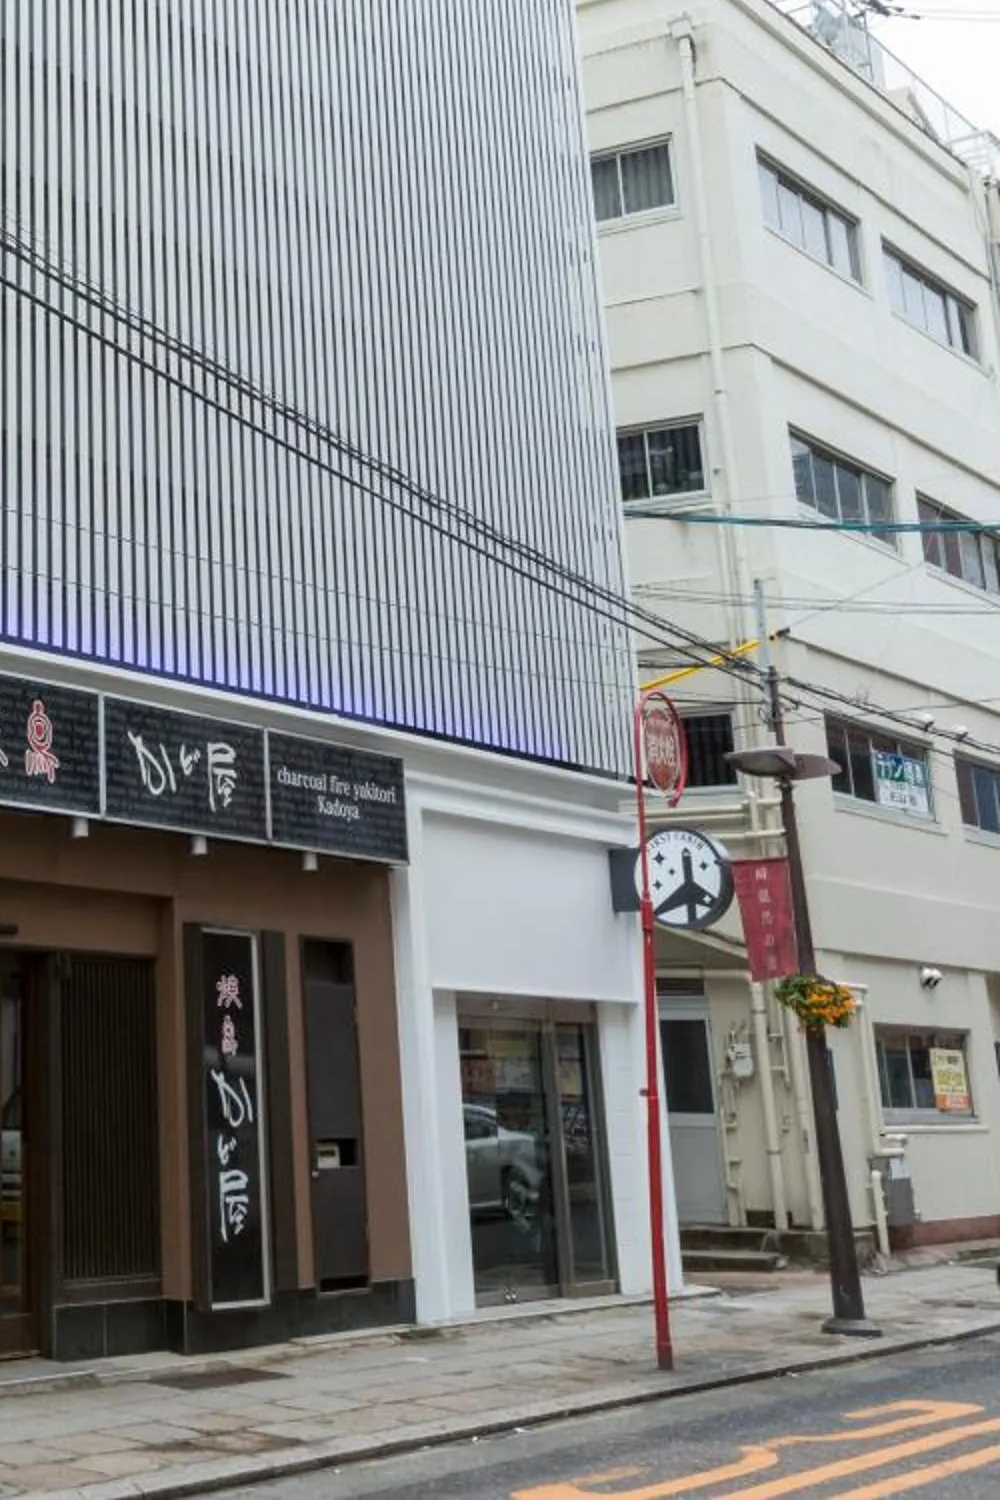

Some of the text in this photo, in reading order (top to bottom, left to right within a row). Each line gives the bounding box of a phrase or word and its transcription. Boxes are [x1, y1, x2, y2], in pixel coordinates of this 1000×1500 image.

[277, 765, 396, 805] charcoal fire yakitori
[317, 794, 360, 822] Kadoya
